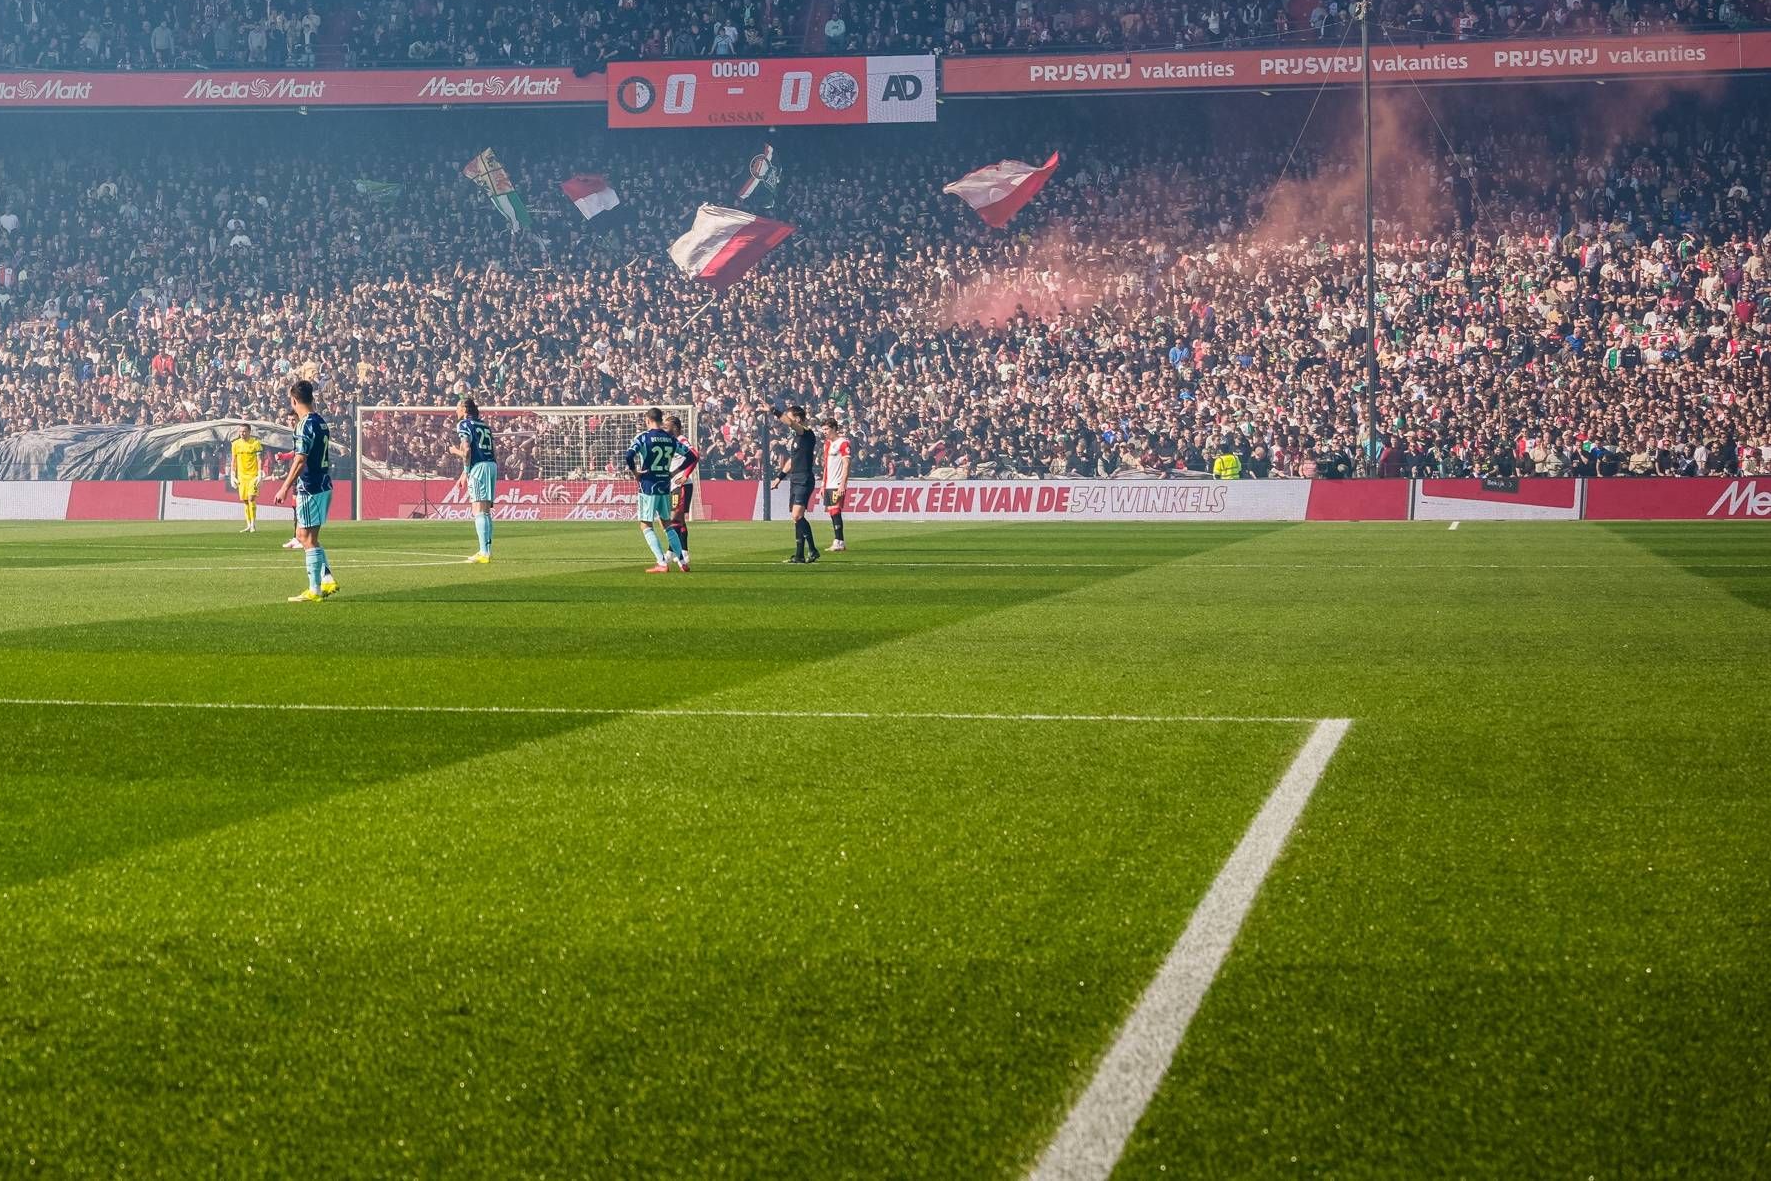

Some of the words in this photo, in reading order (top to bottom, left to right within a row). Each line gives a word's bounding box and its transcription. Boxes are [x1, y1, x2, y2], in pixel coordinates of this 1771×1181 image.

[1372, 53, 1469, 72] vakanties
[1607, 45, 1706, 65] vakanties
[711, 61, 760, 78] 00:00
[1140, 61, 1235, 79] vakanties
[34, 79, 93, 100] Markt
[183, 78, 249, 99] Media
[266, 78, 326, 99] Markt
[418, 76, 484, 98] Media
[501, 75, 562, 97] Markt
[663, 73, 697, 114] 0
[779, 71, 813, 112] 0
[881, 74, 923, 102] AD
[476, 427, 493, 451] 25
[650, 445, 674, 472] 23
[842, 486, 925, 513] EZOEK
[924, 482, 969, 513] ÉÉN
[980, 486, 1032, 513] VAN
[1035, 486, 1071, 513] DE
[1070, 486, 1106, 513] 54
[1110, 486, 1228, 513] WINKELS
